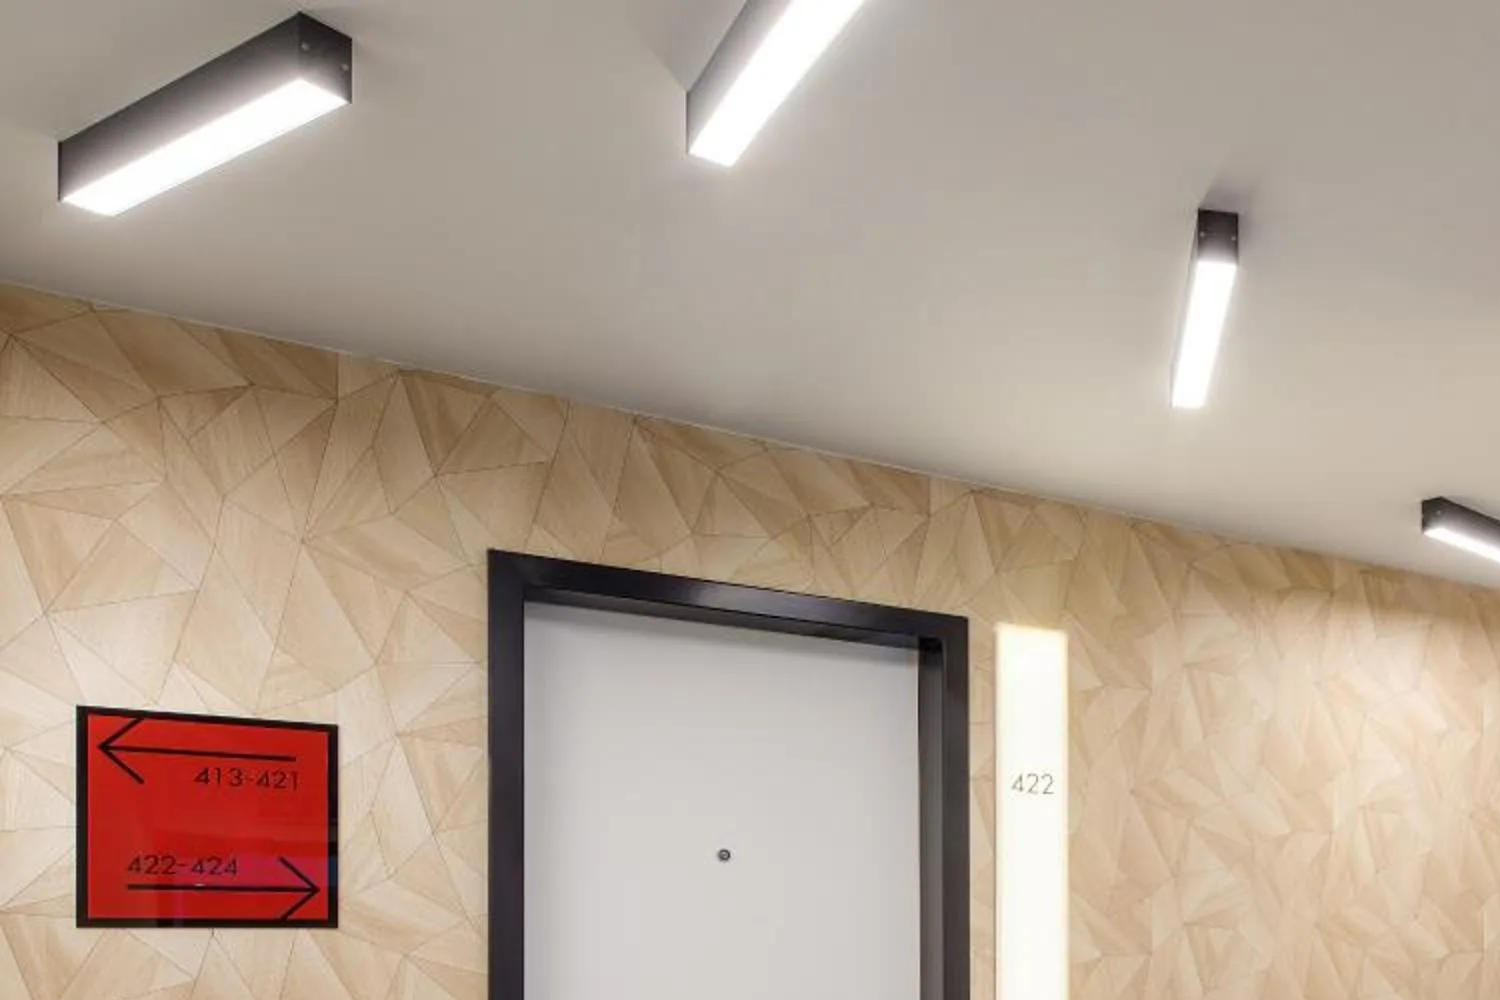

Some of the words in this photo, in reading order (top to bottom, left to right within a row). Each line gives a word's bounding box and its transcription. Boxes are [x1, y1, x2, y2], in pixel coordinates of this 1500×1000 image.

[194, 767, 299, 791] 413-421
[1011, 773, 1055, 794] 422
[127, 854, 238, 877] 422-424
